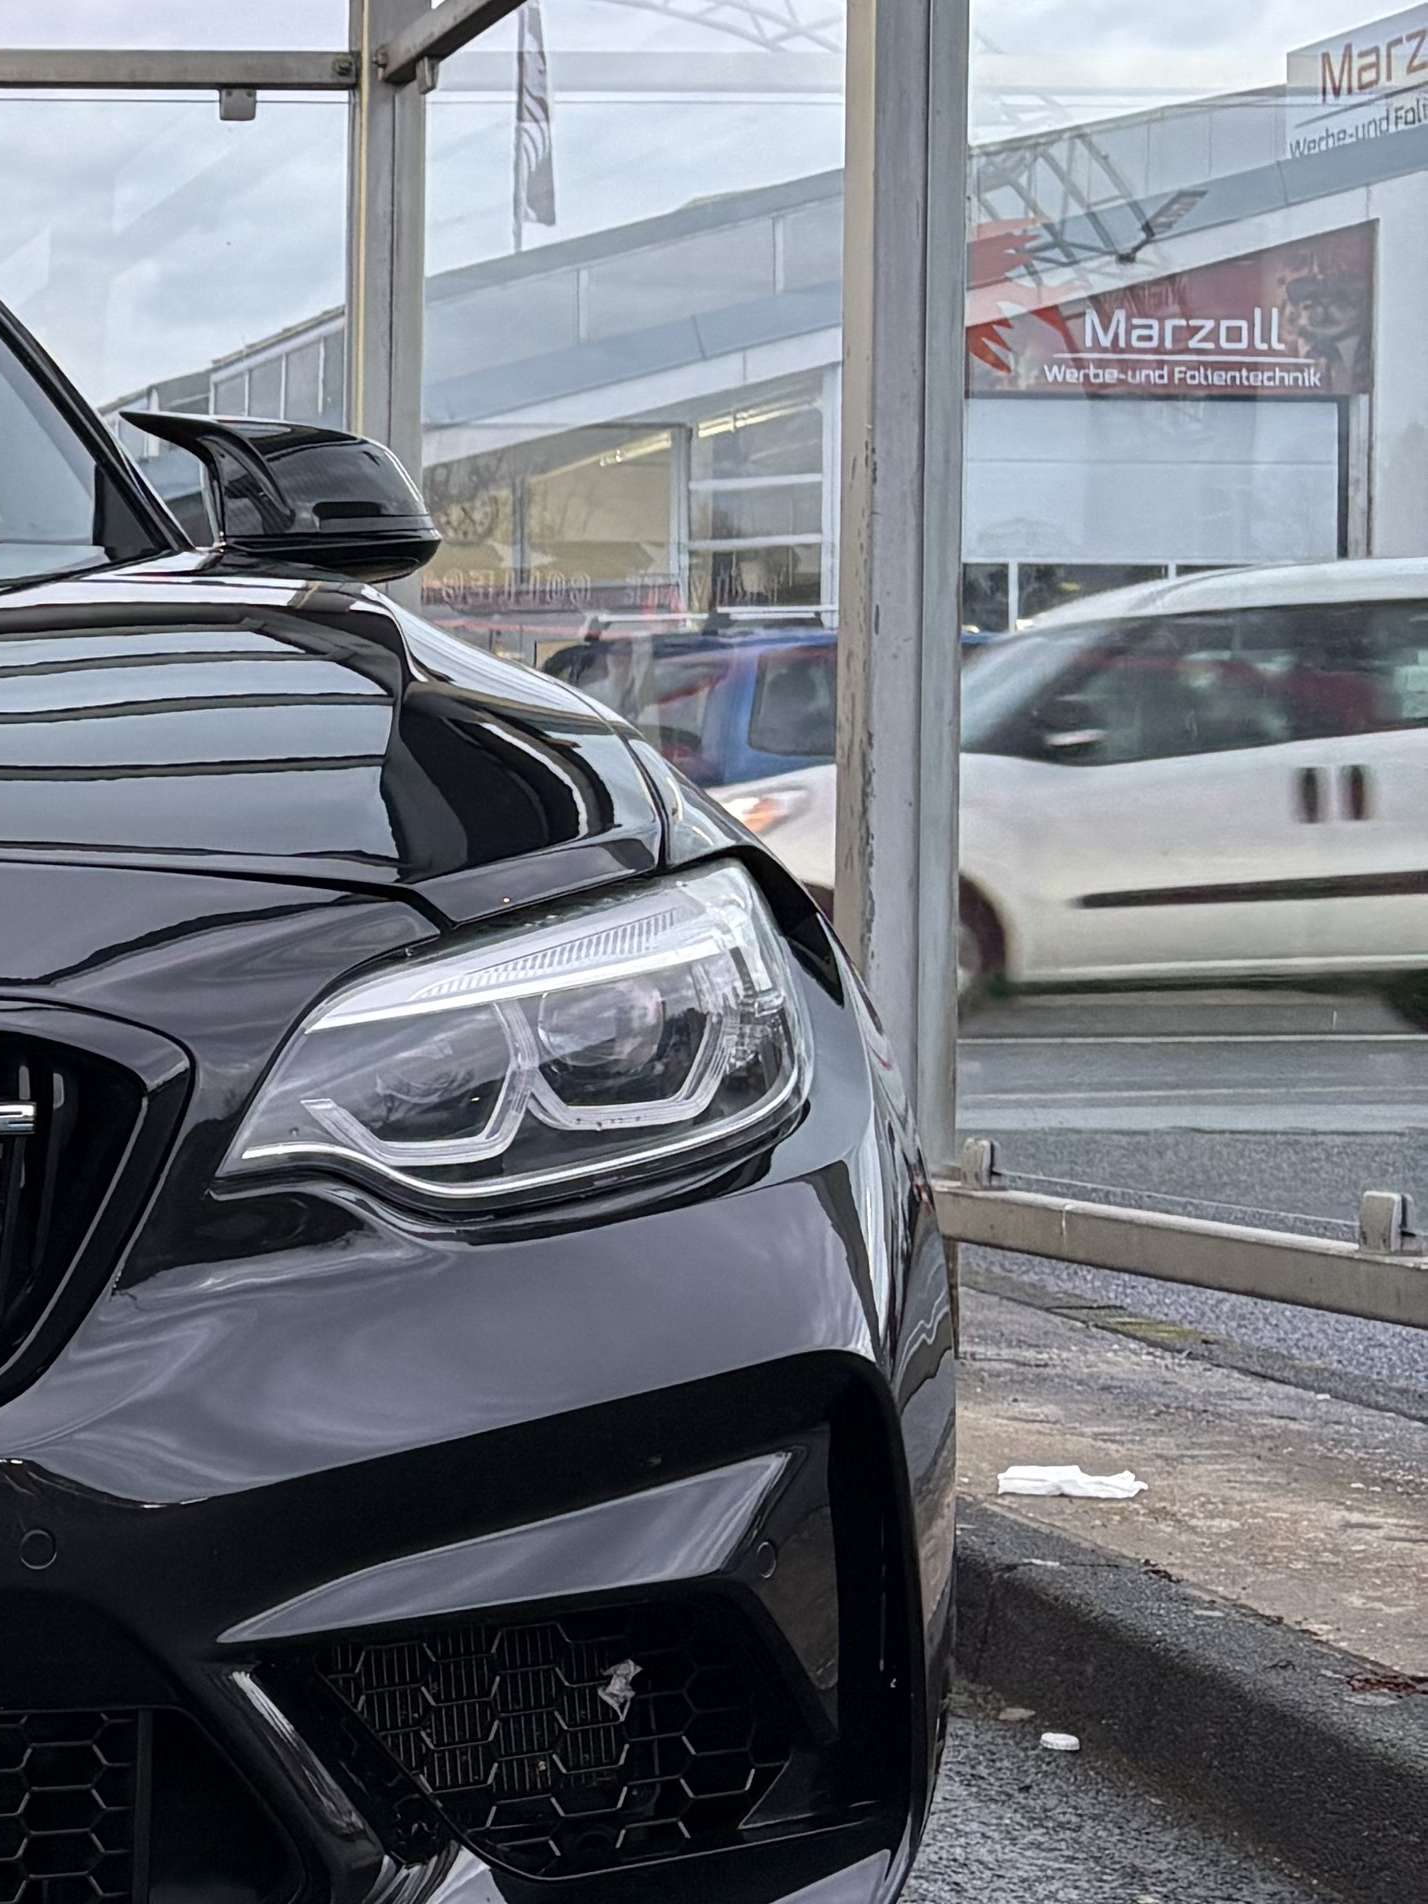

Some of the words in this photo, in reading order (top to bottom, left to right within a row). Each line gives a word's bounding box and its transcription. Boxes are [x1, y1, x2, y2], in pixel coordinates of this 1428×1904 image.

[1083, 307, 1286, 351] Marzoll
[1043, 363, 1169, 385] Werbe-und
[1173, 366, 1322, 388] Folientechnik
